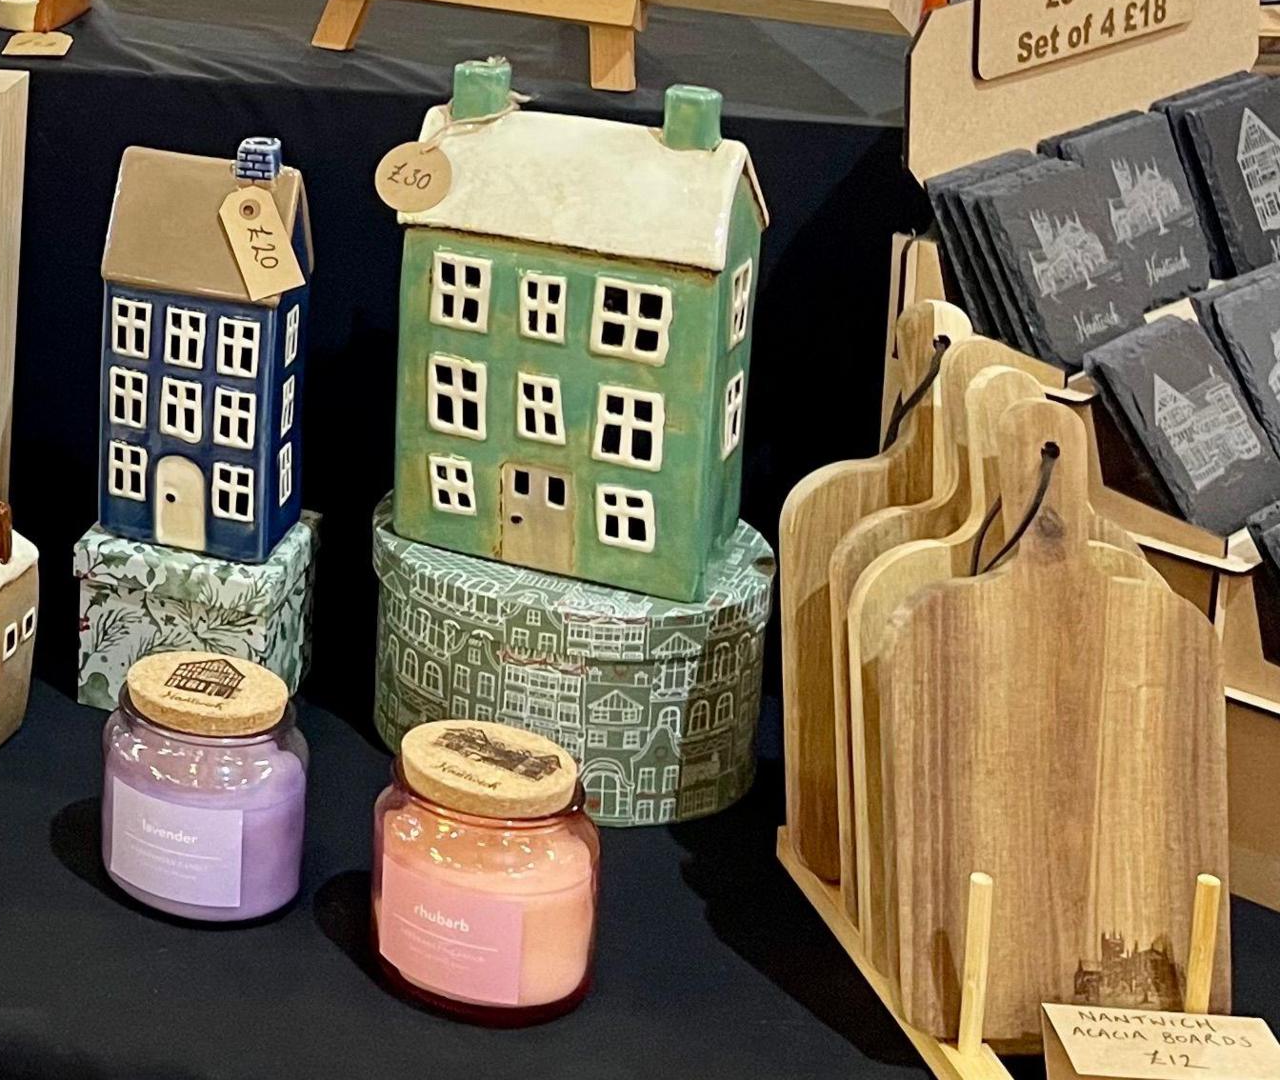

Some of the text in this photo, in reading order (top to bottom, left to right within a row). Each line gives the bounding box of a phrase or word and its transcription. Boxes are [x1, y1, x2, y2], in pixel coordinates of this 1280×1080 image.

[1017, 23, 1060, 63] Set
[1068, 13, 1093, 49] of
[1100, 7, 1116, 38] 4
[387, 162, 432, 190] £30
[247, 224, 279, 270] £20
[1145, 245, 1191, 288] Nantwich
[1073, 300, 1121, 345] Nantwich
[142, 818, 199, 845] lavender
[414, 904, 471, 933] rhubarb
[1077, 1010, 1217, 1033] NANTWICH
[1072, 1026, 1253, 1048] ACACIA BOARDS
[1143, 1049, 1211, 1070] £12
